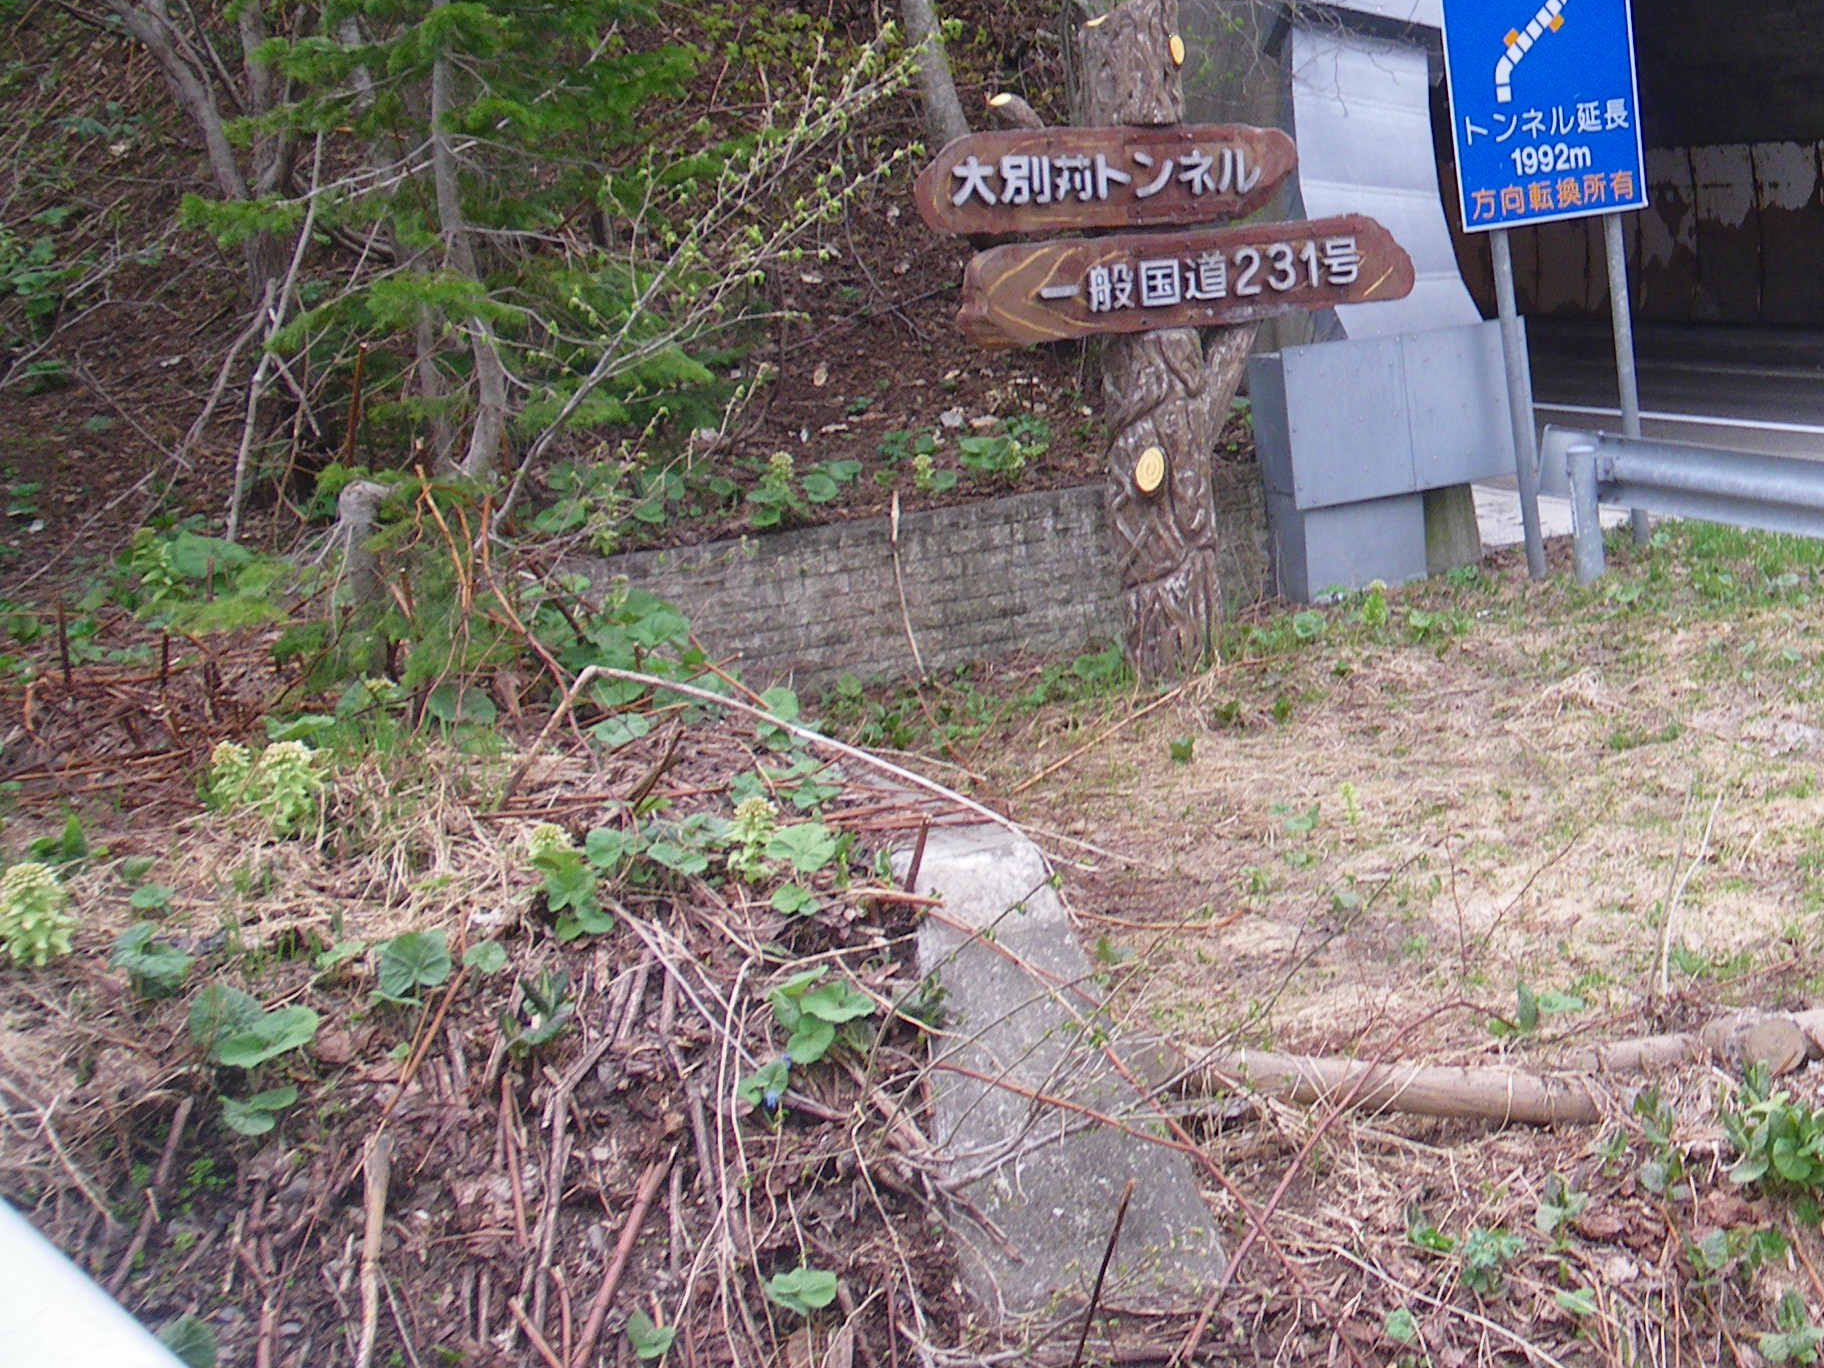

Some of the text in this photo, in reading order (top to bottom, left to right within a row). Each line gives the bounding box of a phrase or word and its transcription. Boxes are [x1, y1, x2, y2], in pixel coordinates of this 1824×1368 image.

[1465, 98, 1630, 146] トンネル延長
[952, 148, 1261, 206] 大別苅トンネル
[1511, 143, 1591, 175] 1992m
[1471, 170, 1634, 220] 方向転換所有
[1040, 236, 1360, 313] 一般国道231号
